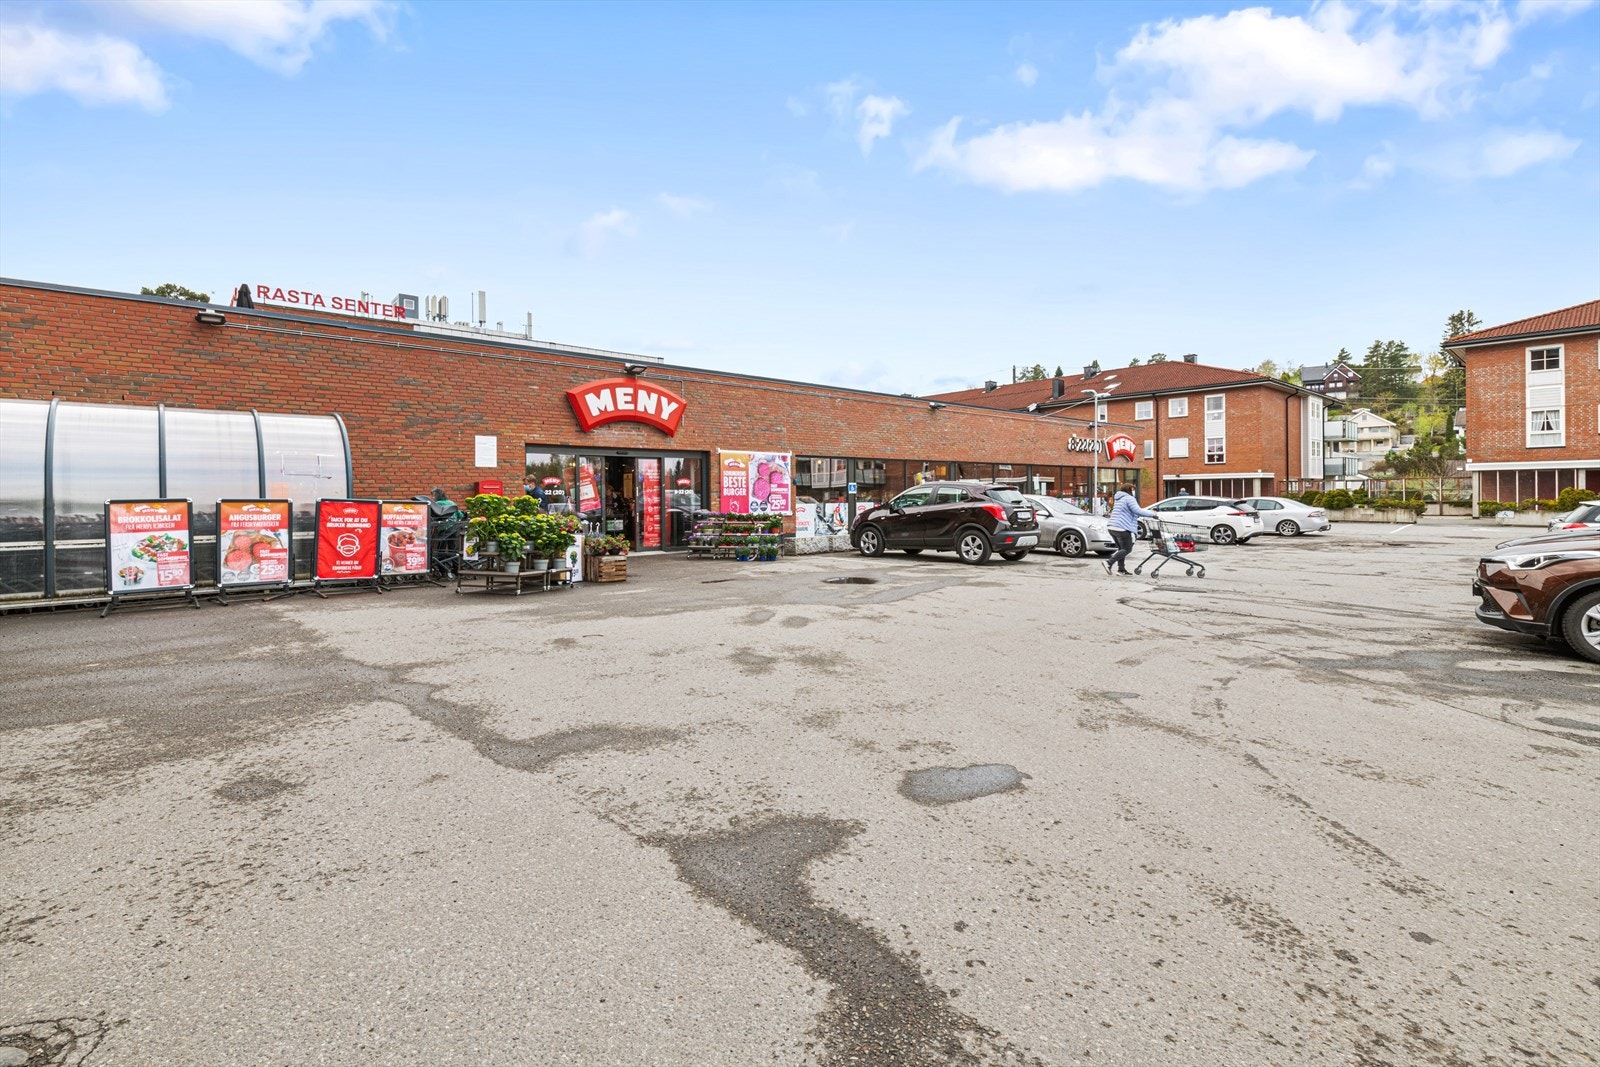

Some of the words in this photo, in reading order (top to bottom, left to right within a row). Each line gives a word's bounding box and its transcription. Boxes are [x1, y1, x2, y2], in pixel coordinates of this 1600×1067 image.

[256, 284, 326, 308] RASTA
[331, 296, 406, 320] SENTER
[584, 387, 680, 421] MENY
[1112, 437, 1137, 454] MENY
[723, 476, 747, 488] BESTE
[723, 487, 747, 496] BURGER
[117, 514, 182, 524] BROKKOLISALAT
[228, 513, 282, 522] ANGUSBURGER
